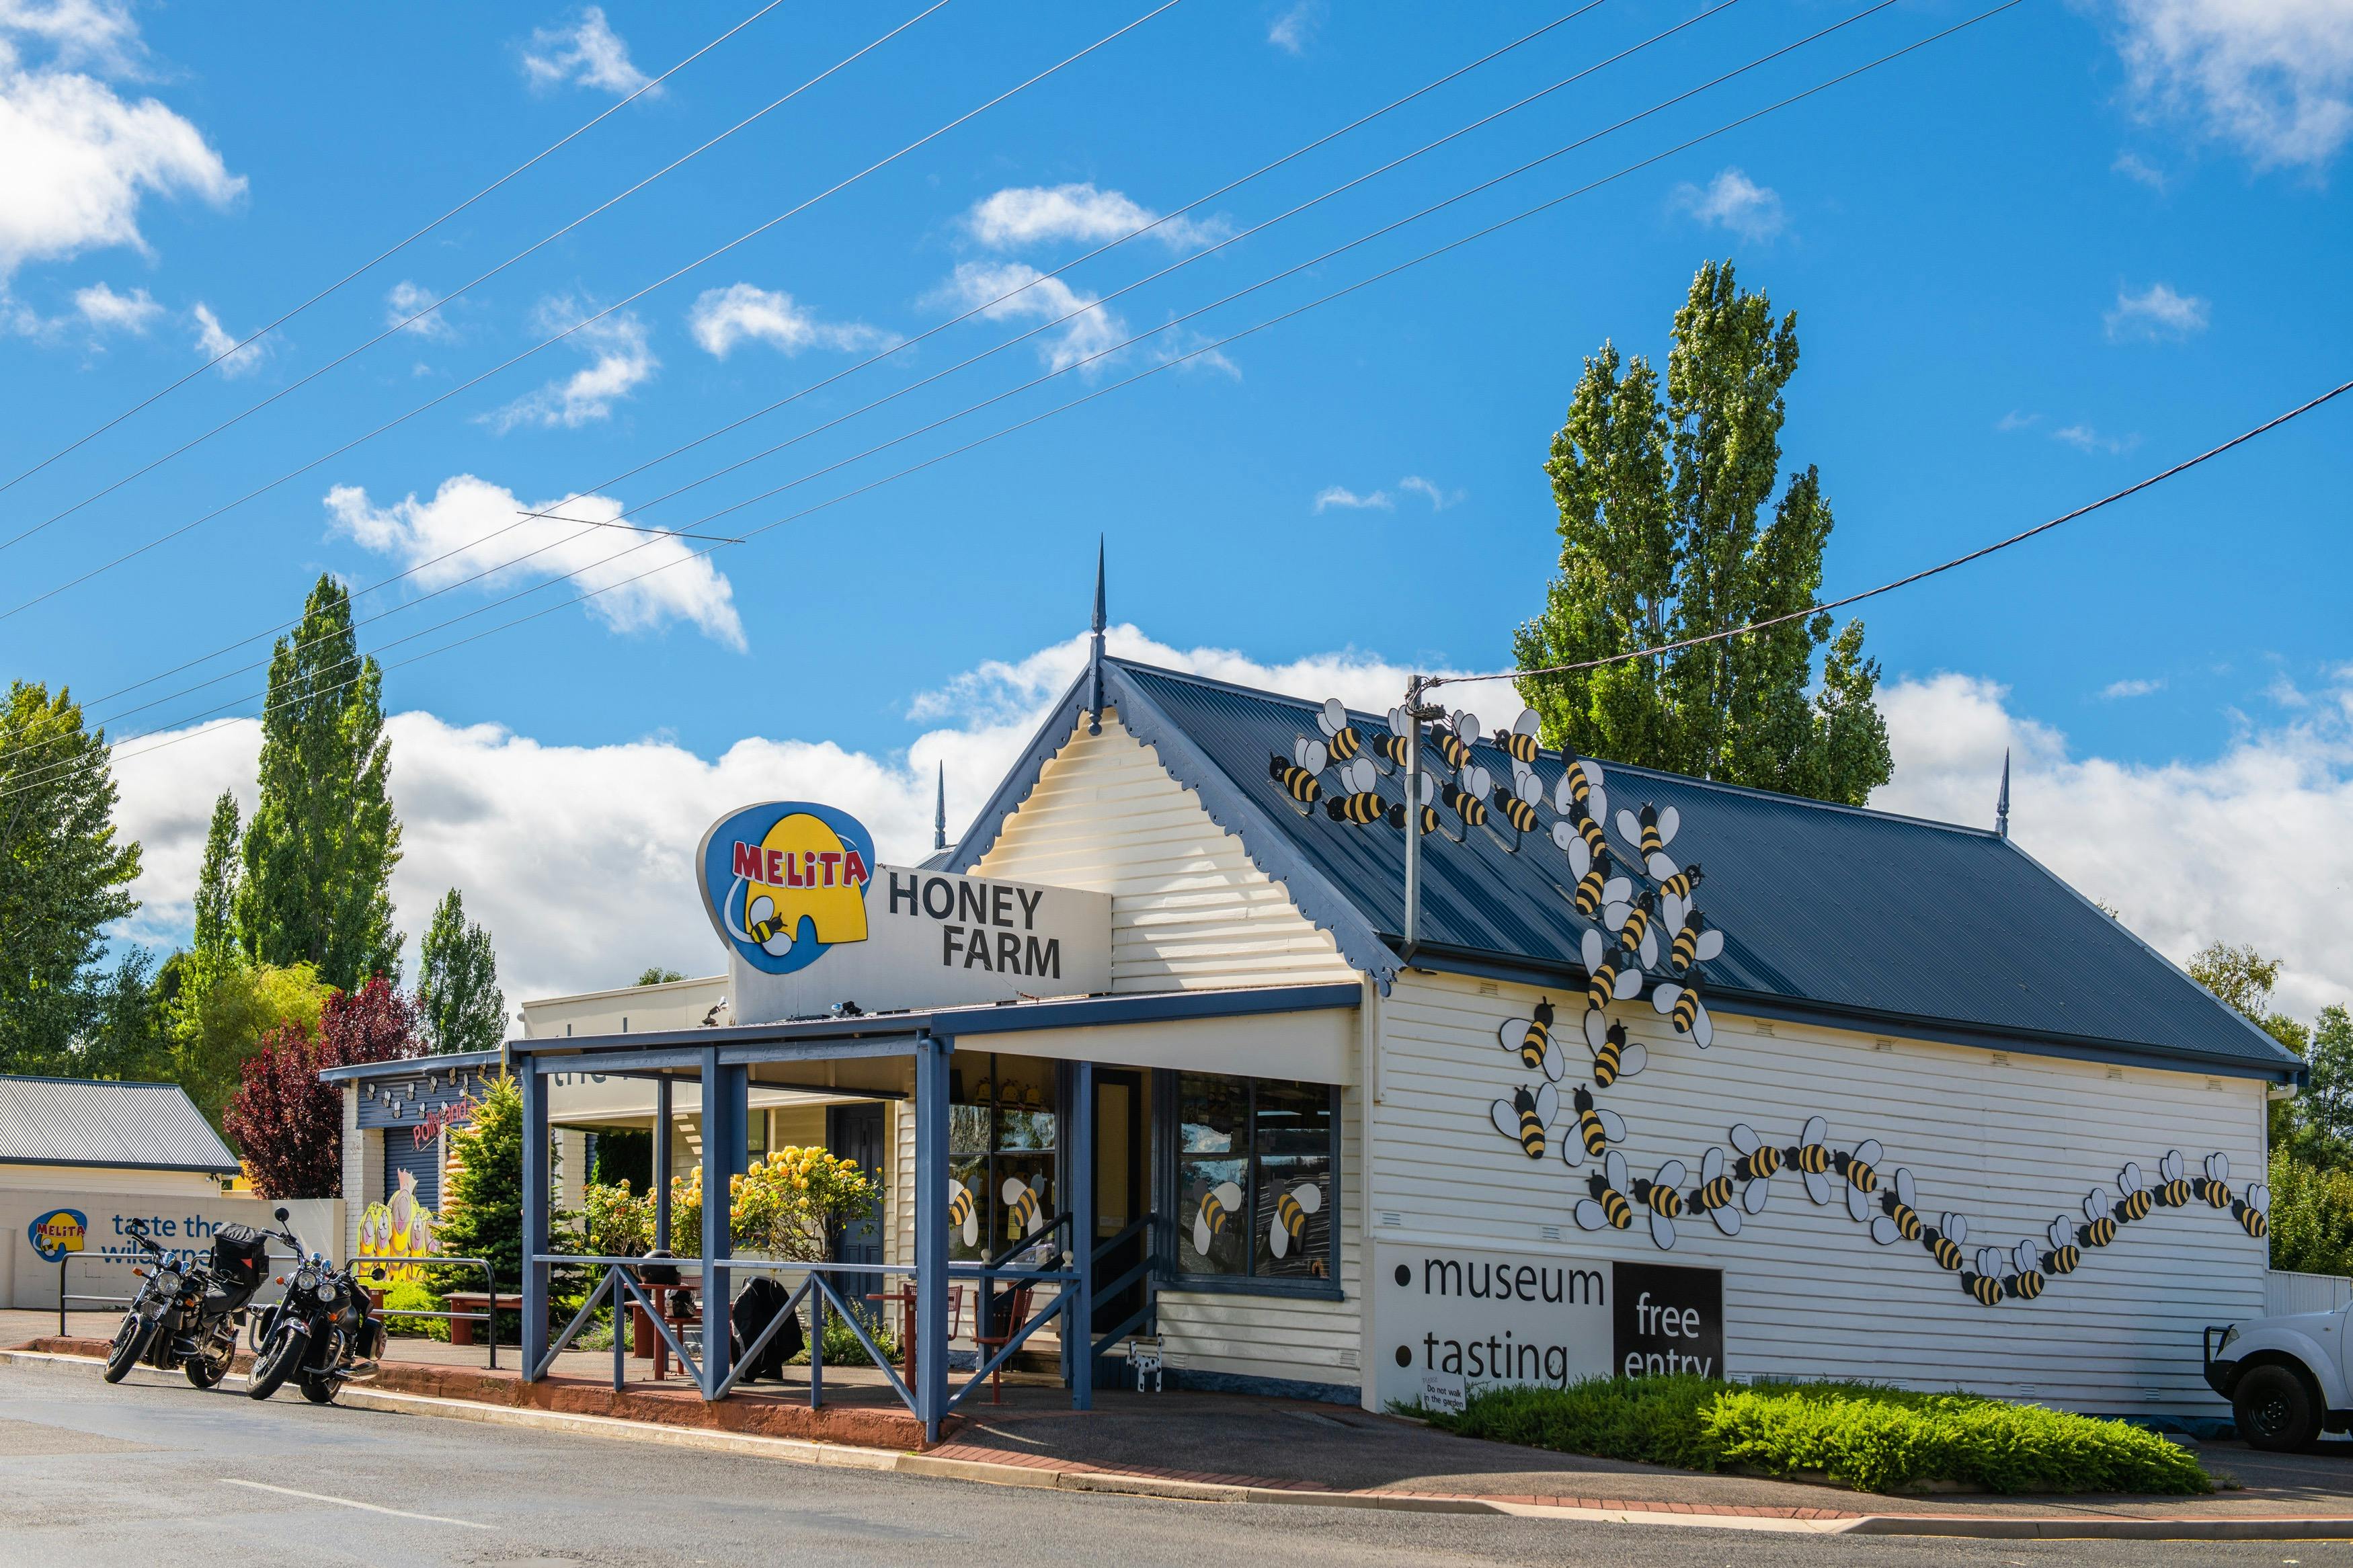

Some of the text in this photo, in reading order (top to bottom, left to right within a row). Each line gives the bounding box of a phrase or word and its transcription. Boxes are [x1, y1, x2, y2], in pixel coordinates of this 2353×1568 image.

[889, 872, 1043, 930] HONEY
[943, 925, 1060, 979] FARM
[444, 1096, 467, 1125] and
[112, 1214, 177, 1237] taste
[1425, 1259, 1605, 1306] museum
[1636, 1292, 1700, 1338] free
[1423, 1330, 1568, 1390] tasting
[1624, 1348, 1712, 1382] entry
[1424, 1393, 1464, 1408] in the garden
[1427, 1385, 1435, 1393] Do
[1448, 1389, 1462, 1398] walk
